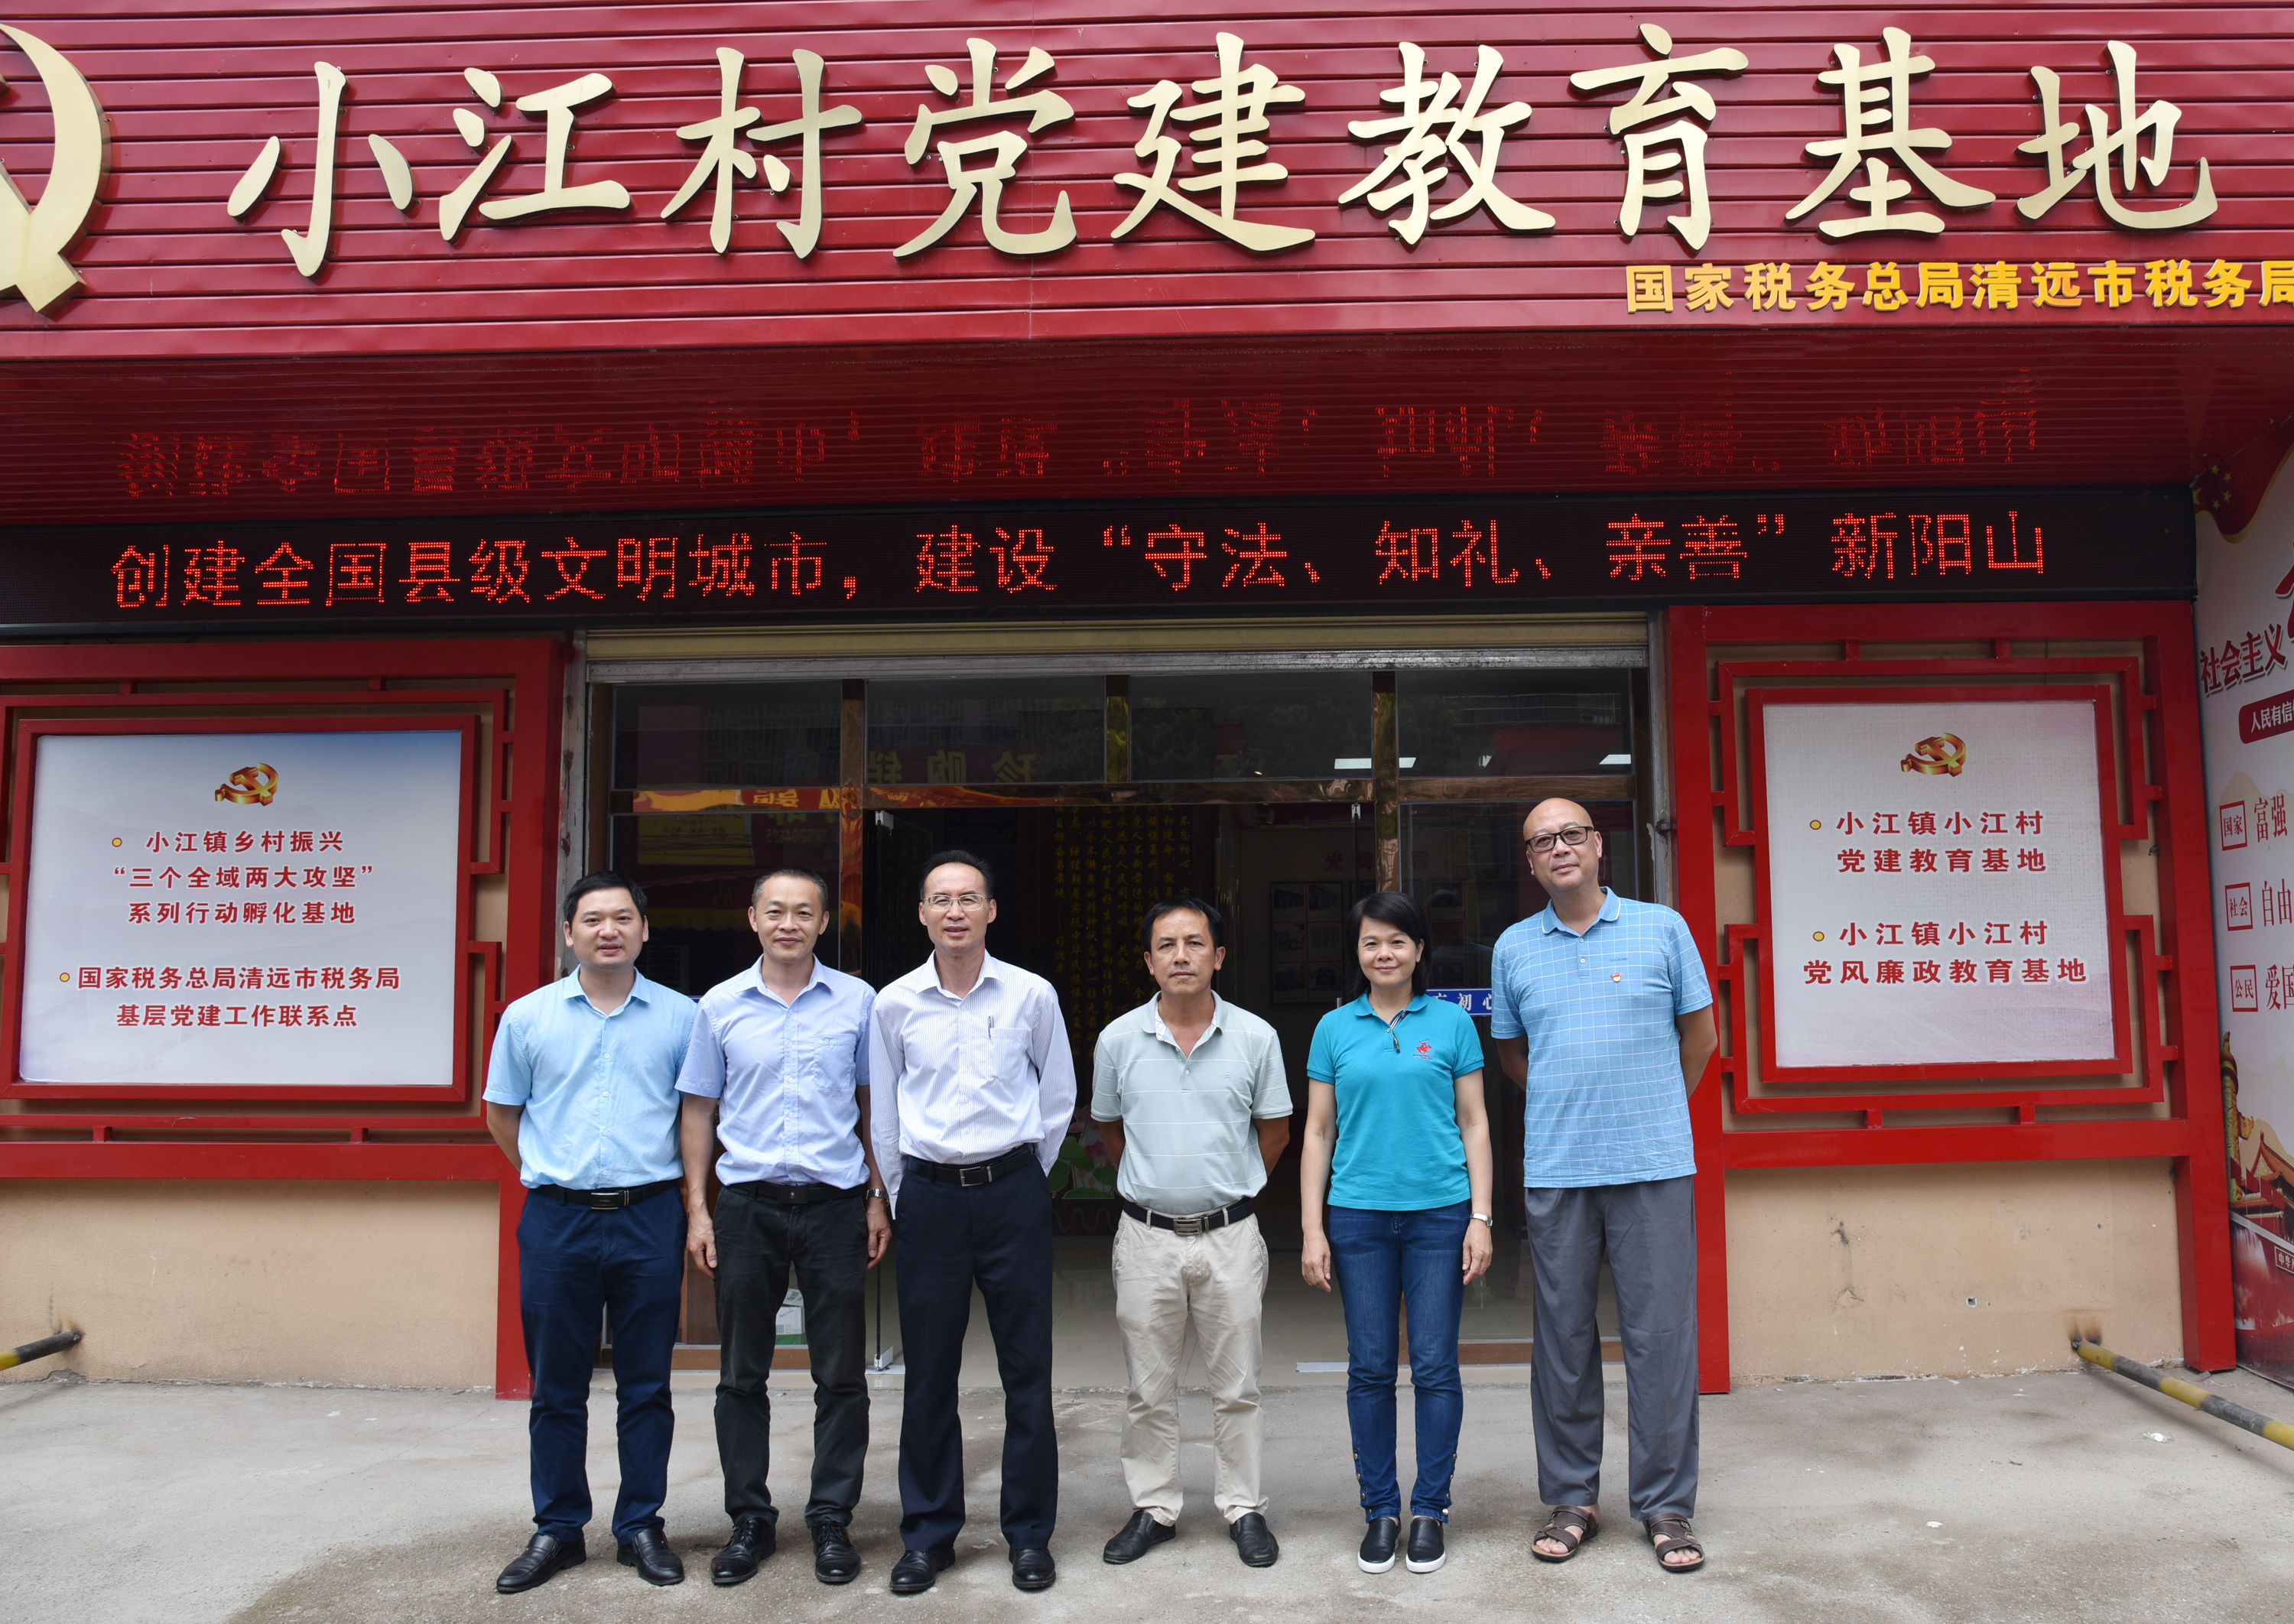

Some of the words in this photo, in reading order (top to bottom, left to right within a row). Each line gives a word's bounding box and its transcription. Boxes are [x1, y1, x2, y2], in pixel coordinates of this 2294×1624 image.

[227, 23, 2218, 278] 小江村党建教育基地
[1626, 259, 2294, 312] 国家税务总局清远市税务局
[2200, 623, 2286, 694] 社会主义
[2250, 699, 2294, 733] 人民有信
[1836, 810, 2044, 835] 小江镇小江村
[2223, 815, 2244, 837] 国家
[2254, 794, 2288, 843] 富强
[146, 830, 344, 853] 小江镇乡村振兴
[1837, 848, 2046, 872] 党建教育基地
[114, 866, 373, 888] “三个全域两大攻坚”
[128, 901, 356, 924] 系列行动孵化基地
[2229, 896, 2248, 918] 社会
[2262, 879, 2292, 927] 自由
[1839, 921, 2048, 946] 小江镇小江村
[78, 966, 400, 989] 国家税务总局清远市税务局
[1803, 957, 2087, 984] 党风廉政教育基地
[2234, 978, 2254, 999] 公民
[2265, 964, 2294, 1010] 爱国
[1432, 992, 1493, 1012] 初心
[116, 1004, 358, 1027] 基层党建工作联系点
